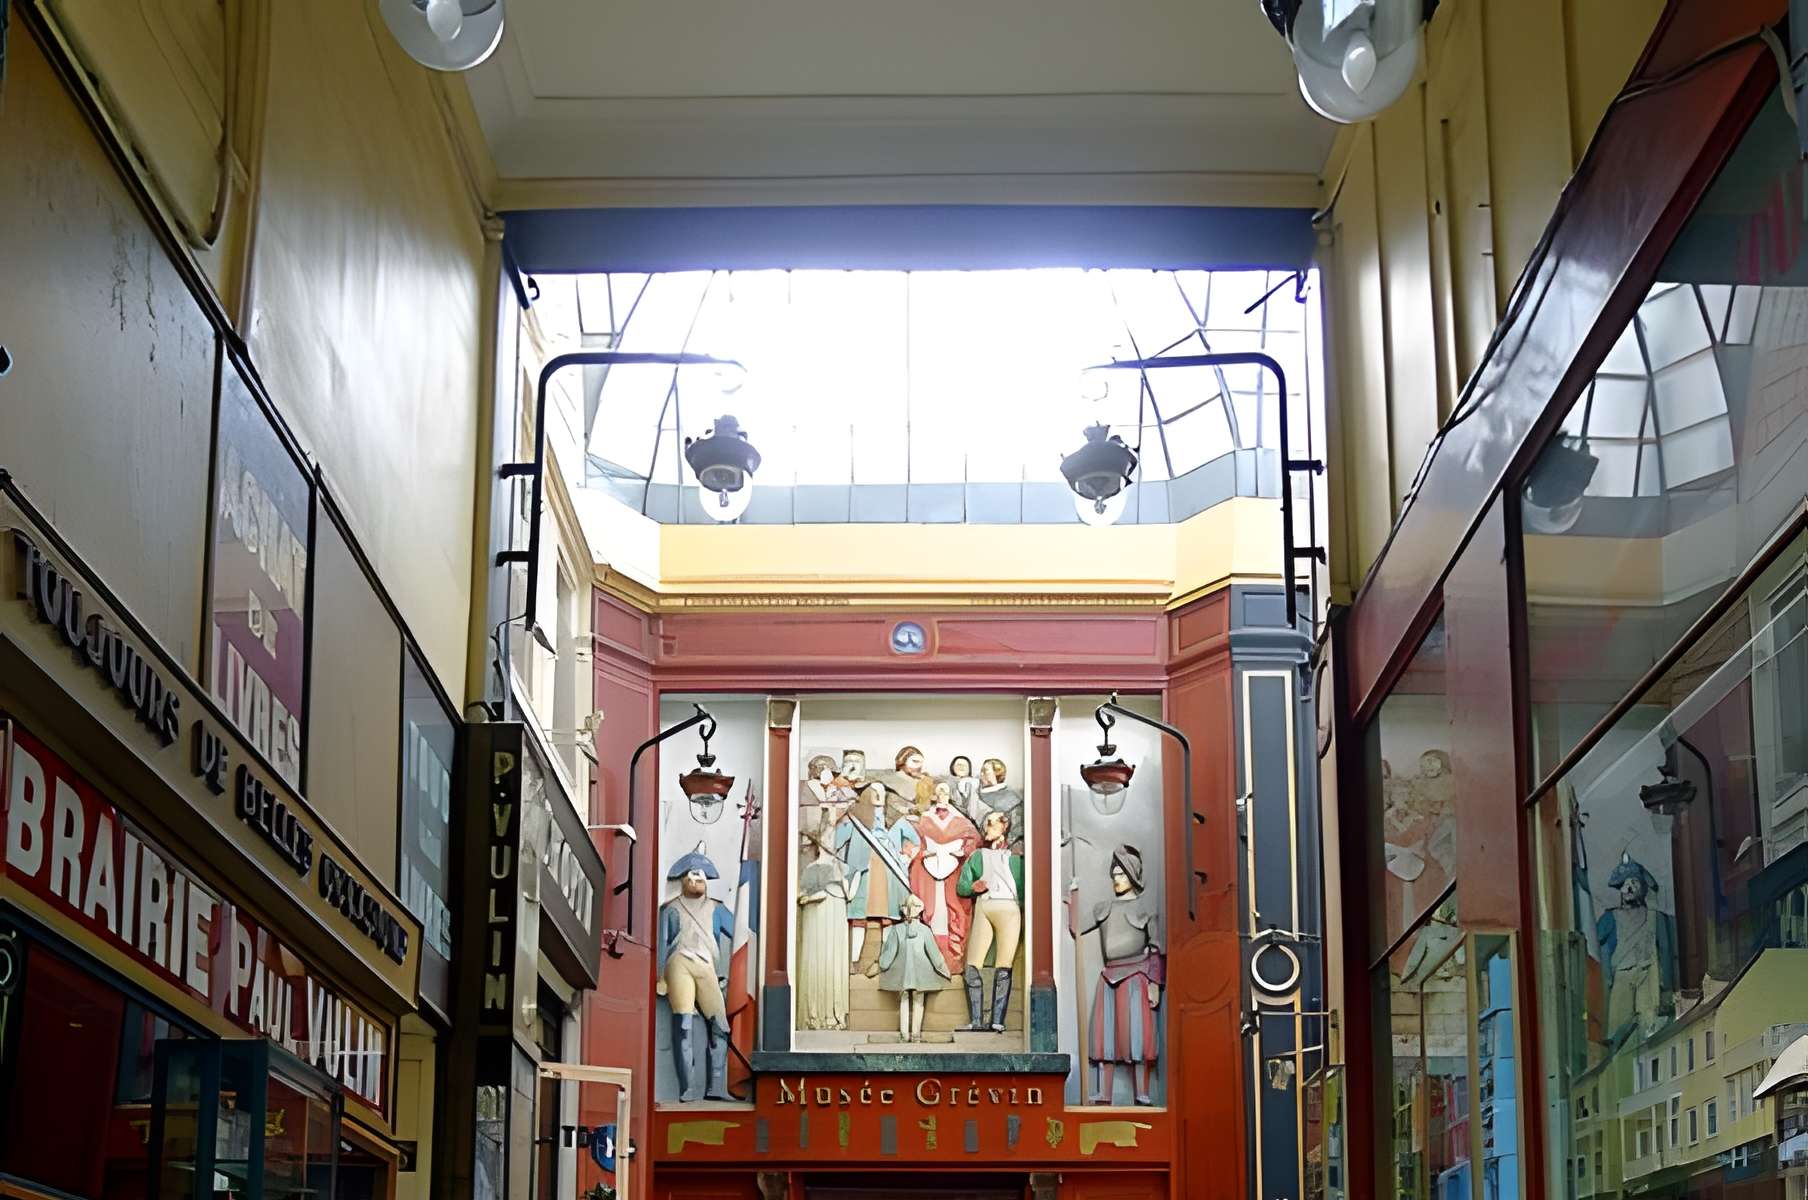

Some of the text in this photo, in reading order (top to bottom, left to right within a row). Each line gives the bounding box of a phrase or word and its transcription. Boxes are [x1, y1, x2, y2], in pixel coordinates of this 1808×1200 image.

[14, 528, 180, 746] TOUJOURS
[193, 722, 228, 793] DE
[5, 741, 215, 998] BRAIRIE
[230, 904, 298, 1056] PAUL
[916, 1077, 1043, 1106] Grévin
